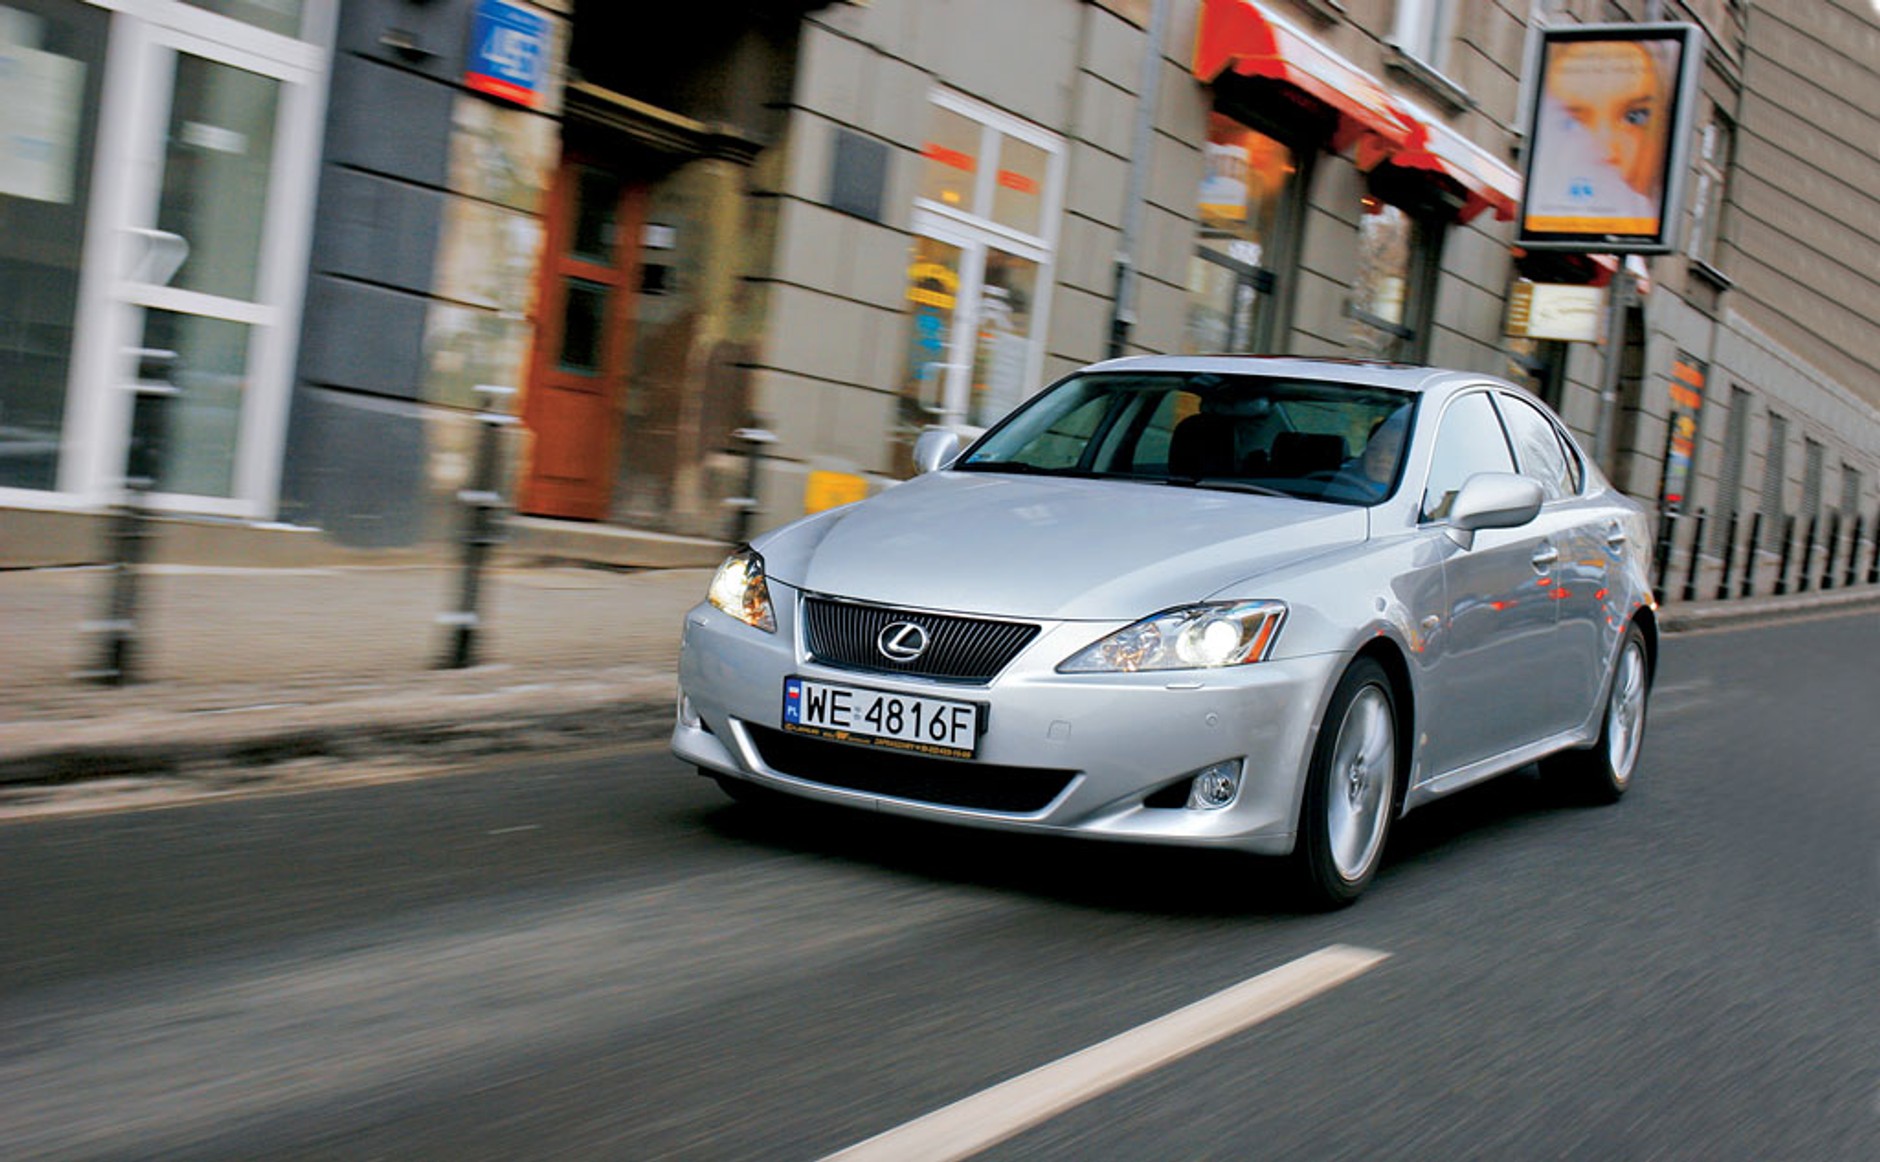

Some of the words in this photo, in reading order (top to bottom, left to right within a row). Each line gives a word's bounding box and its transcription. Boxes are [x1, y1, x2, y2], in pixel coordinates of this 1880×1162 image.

[787, 704, 799, 718] PL
[807, 687, 852, 727] WE
[864, 696, 972, 743] 4816F
